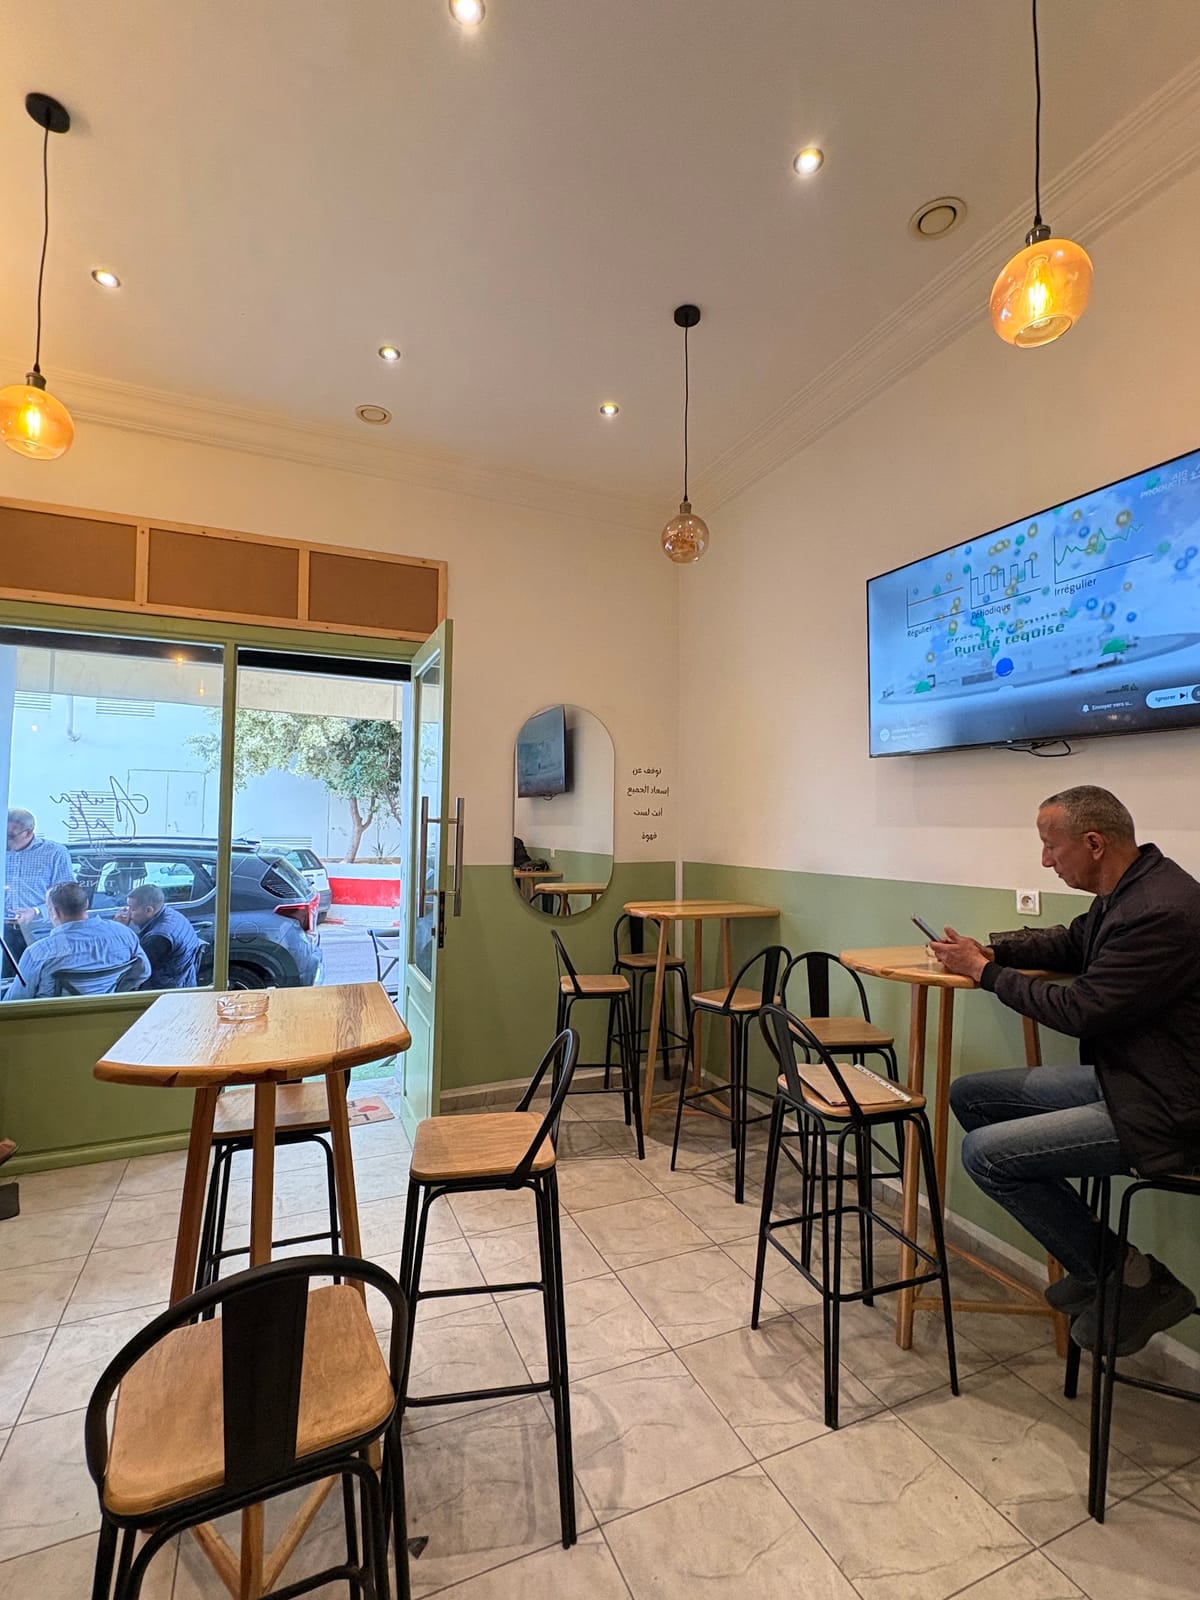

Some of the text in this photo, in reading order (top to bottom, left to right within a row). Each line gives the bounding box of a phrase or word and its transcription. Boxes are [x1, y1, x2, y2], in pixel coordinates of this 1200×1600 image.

[1054, 578, 1097, 597] Irrégulier
[954, 622, 1065, 656] Pureté requise
